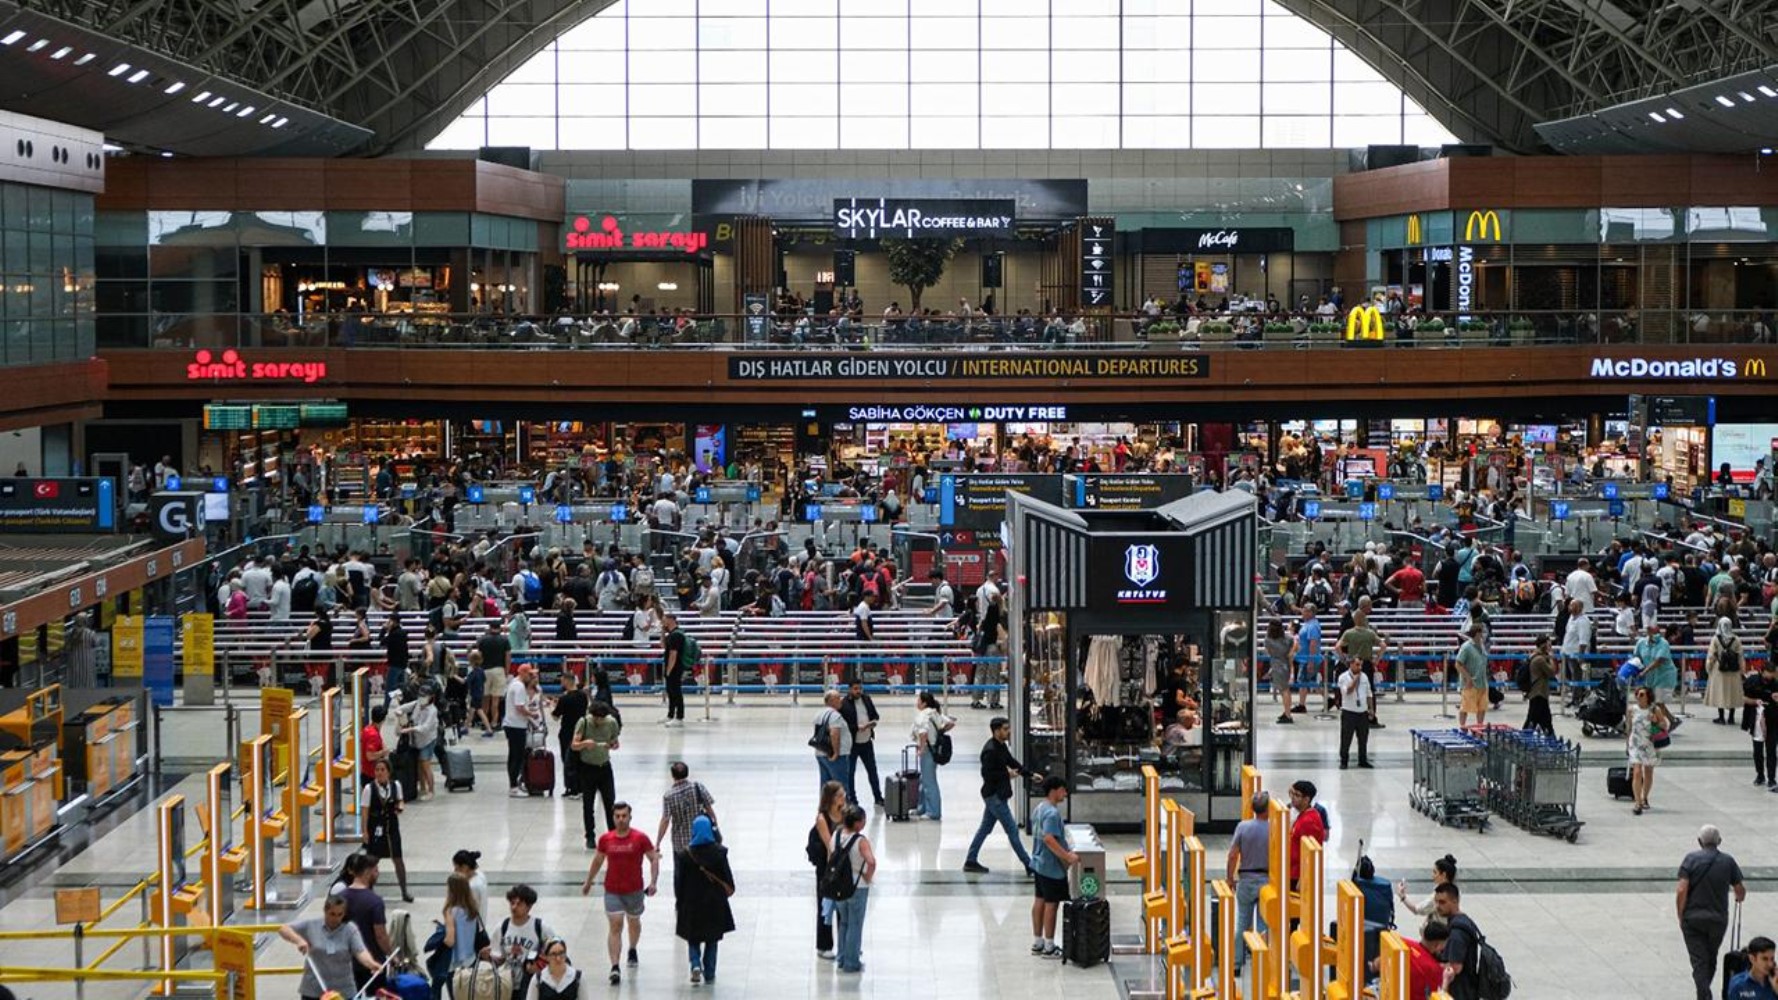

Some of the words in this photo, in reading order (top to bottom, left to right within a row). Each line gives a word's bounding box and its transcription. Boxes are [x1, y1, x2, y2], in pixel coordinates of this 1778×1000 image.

[838, 201, 921, 235] SKYLAR
[922, 217, 966, 229] COFFEE
[566, 216, 624, 248] simit
[632, 232, 707, 253] sarayı
[187, 350, 247, 379] simit
[252, 362, 326, 382] sarayı
[739, 360, 765, 378] DIŞ
[771, 360, 832, 376] HATLAR
[838, 357, 889, 376] GİDEN
[894, 360, 947, 376] YOLCU
[963, 359, 1092, 375] INTERNATIONAL
[1097, 359, 1198, 375] DEPARTURES
[1591, 358, 1737, 377] McDonald's
[849, 405, 900, 420] SABİHA
[903, 405, 965, 422] GÖKÇEN
[984, 407, 1025, 419] DUTY
[1028, 407, 1066, 419] FREE
[159, 501, 188, 534] G
